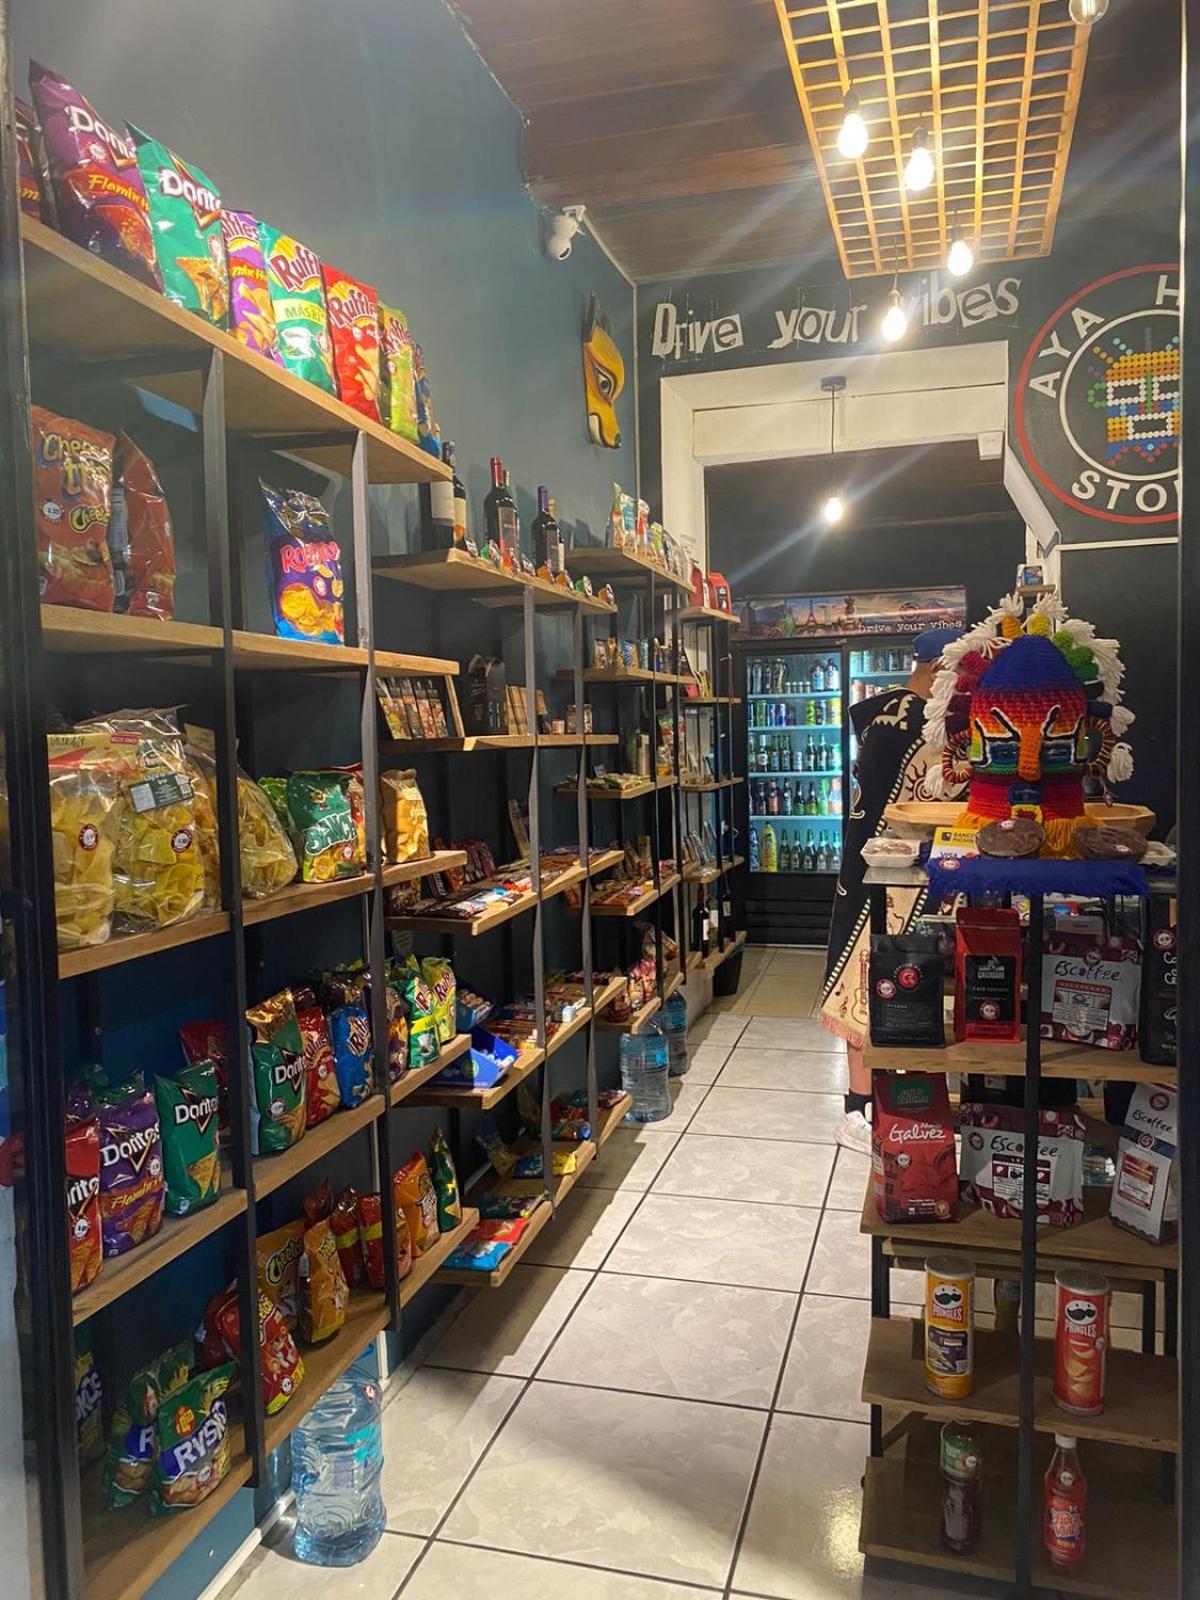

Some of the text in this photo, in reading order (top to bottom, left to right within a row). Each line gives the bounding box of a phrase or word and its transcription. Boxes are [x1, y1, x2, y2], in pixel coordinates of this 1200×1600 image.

[651, 302, 745, 359] Drive
[766, 304, 868, 350] your
[1029, 307, 1105, 399] AYA
[1071, 469, 1182, 513] STO
[896, 622, 926, 632] your
[1064, 1319, 1096, 1337] PRINGLES
